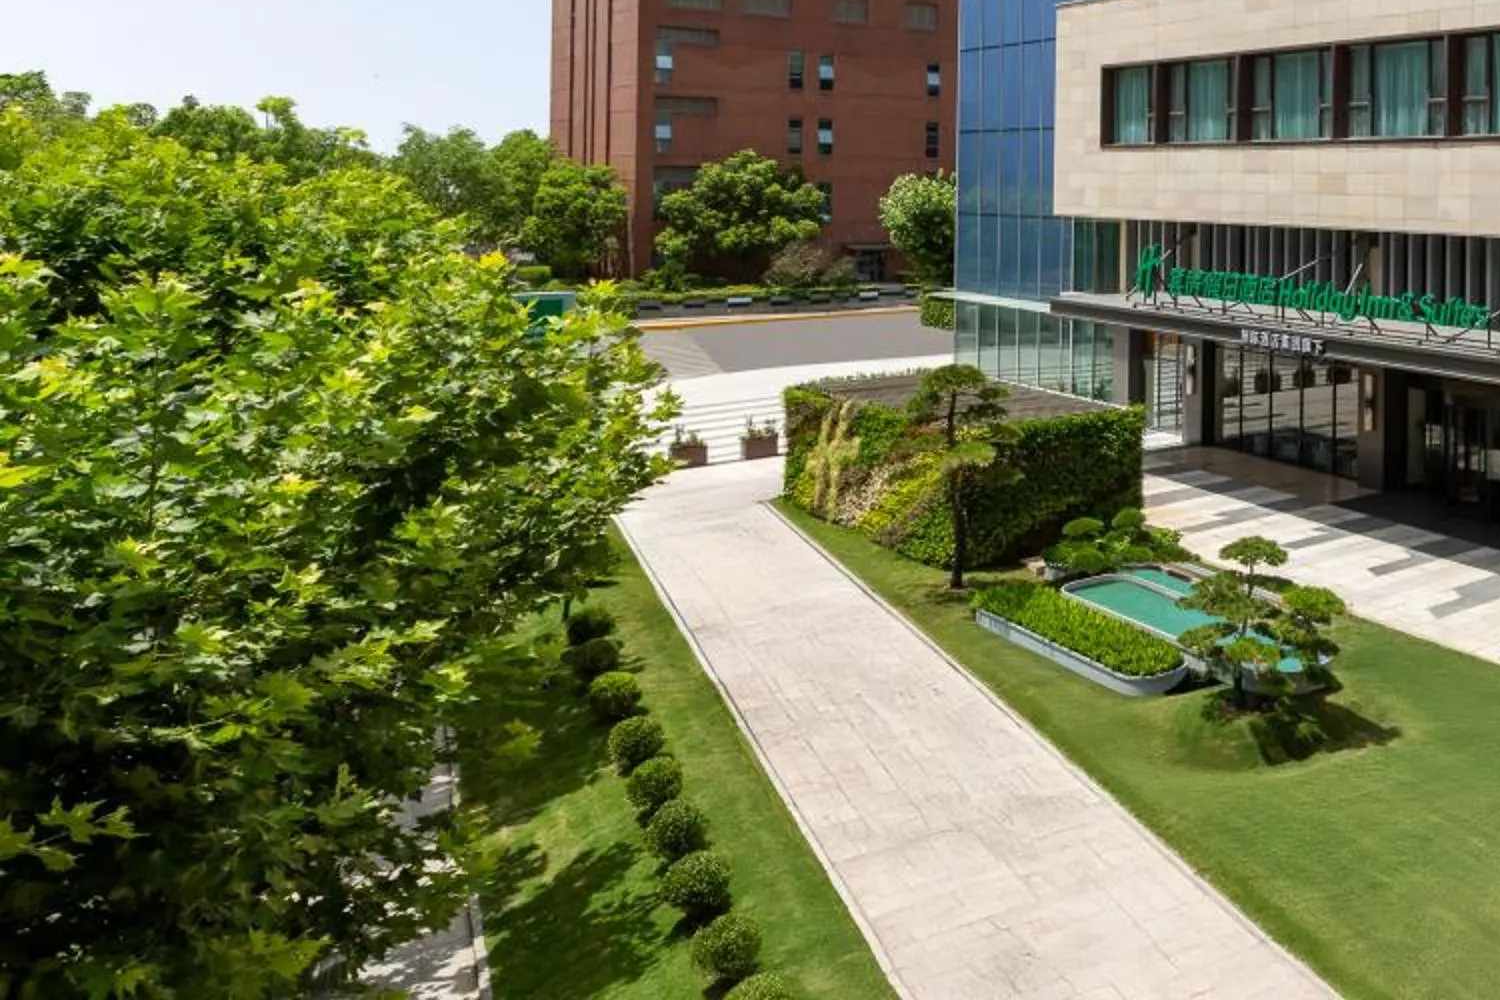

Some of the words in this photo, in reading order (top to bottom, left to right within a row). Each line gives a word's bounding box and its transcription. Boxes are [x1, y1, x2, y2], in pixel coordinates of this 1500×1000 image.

[1168, 267, 1278, 304] 套房假日酒店
[1279, 278, 1359, 321] Holiday
[1420, 293, 1490, 329] Suites
